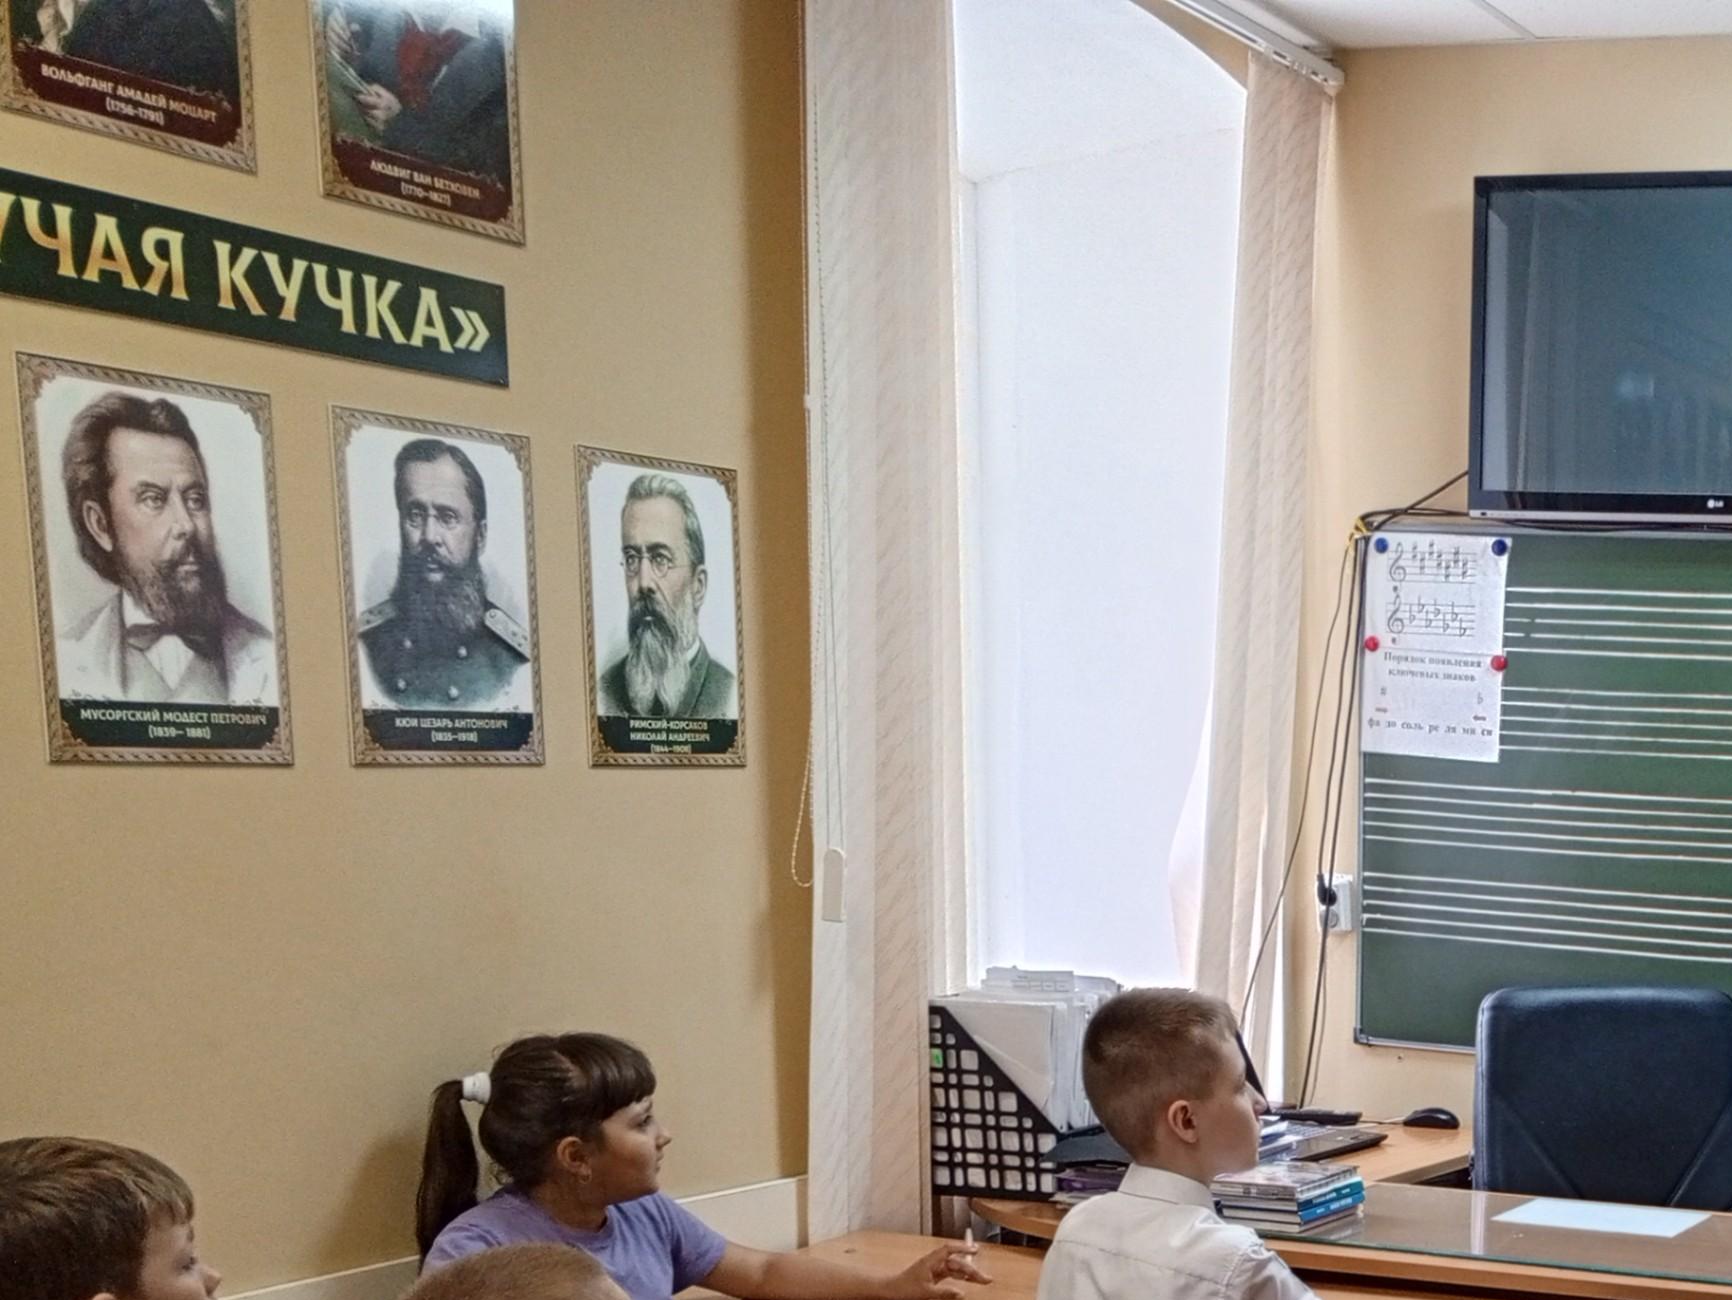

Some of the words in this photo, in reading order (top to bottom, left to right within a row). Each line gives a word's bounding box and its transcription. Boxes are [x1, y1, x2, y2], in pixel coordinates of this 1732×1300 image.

[41, 64, 114, 93] ВОЛЬФГАНГ
[116, 85, 167, 108] АМАДЕЙ
[168, 99, 217, 123] МОЦАРТ
[213, 239, 490, 354] КУЧКА»
[80, 707, 161, 722] МУСОРГСКИЙ
[163, 712, 208, 724] МОДЕСТ
[210, 713, 267, 725] ПЕТРОВИЧ
[395, 717, 418, 728] КЮИ
[420, 718, 452, 728] ЦЕЗАРЬ
[454, 718, 508, 729] АНТОНОВИЧ
